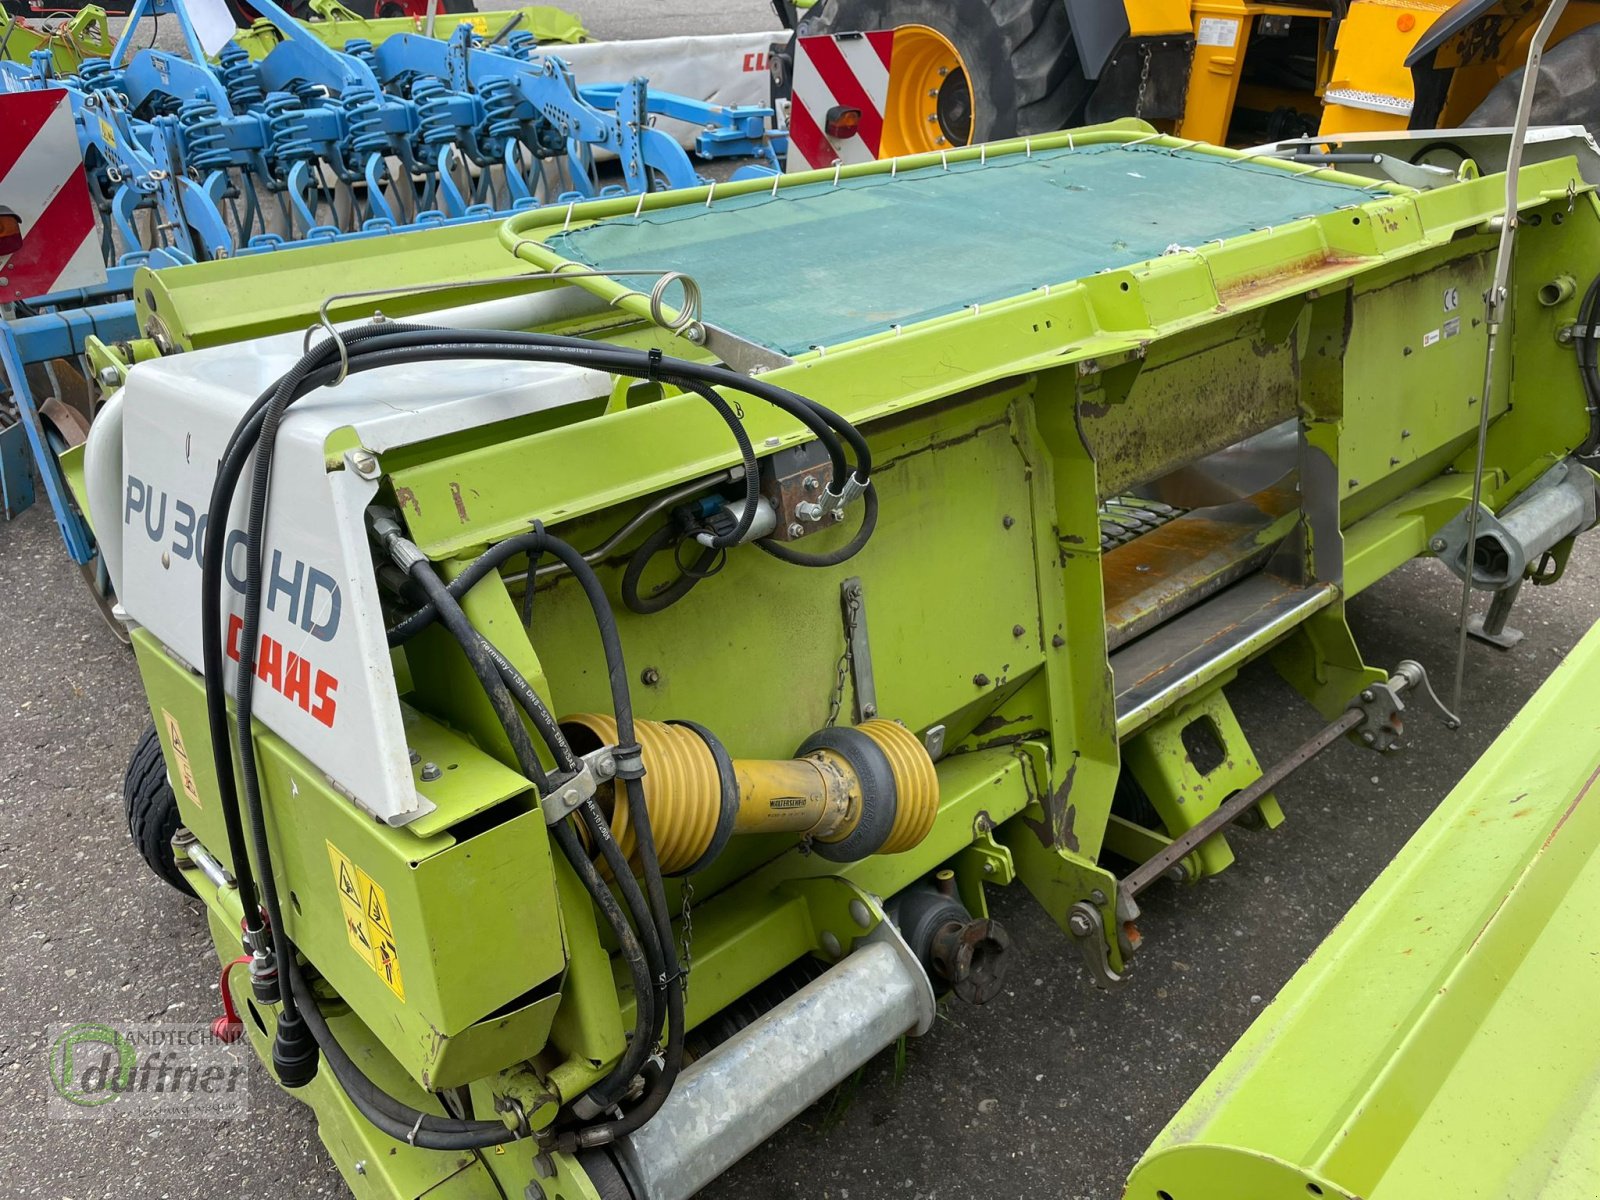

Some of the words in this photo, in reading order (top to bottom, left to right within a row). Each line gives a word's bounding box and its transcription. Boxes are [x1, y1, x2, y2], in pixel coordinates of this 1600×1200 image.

[125, 475, 167, 542] PU
[267, 549, 342, 642] HD
[227, 613, 339, 729] CAAS
